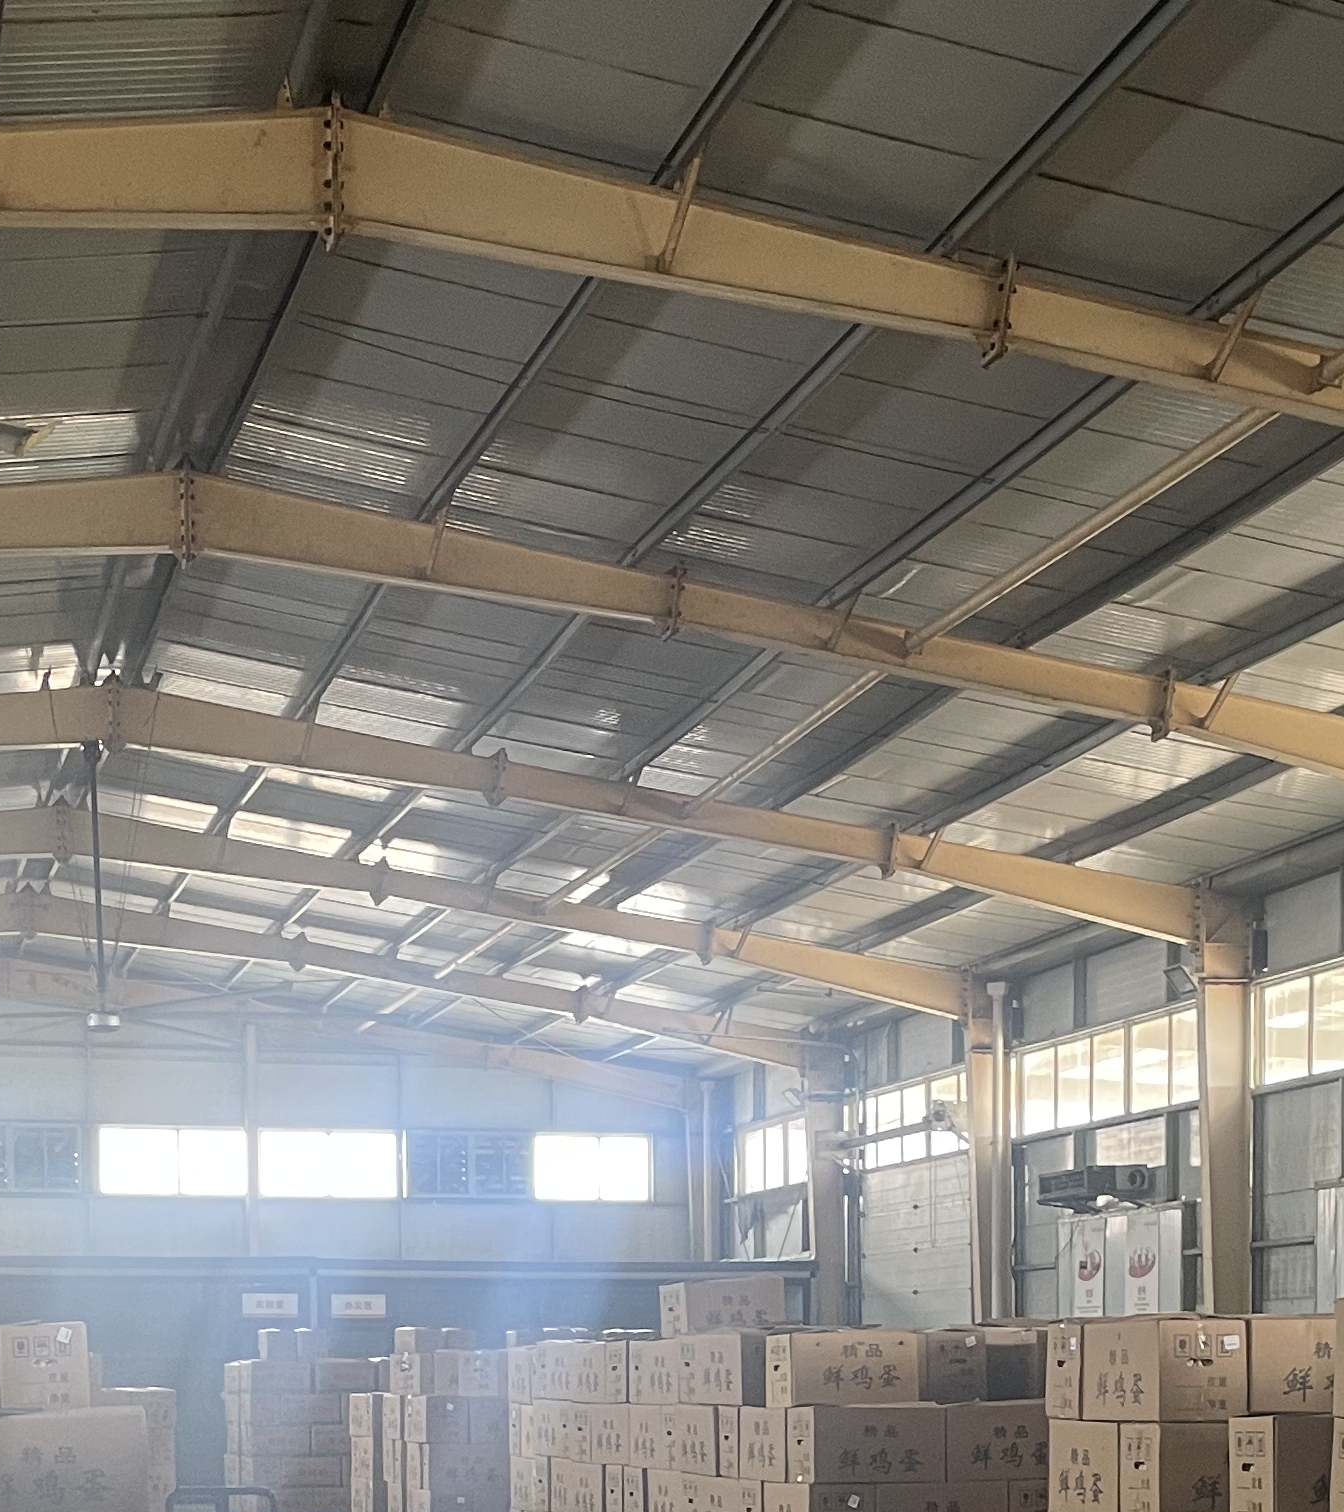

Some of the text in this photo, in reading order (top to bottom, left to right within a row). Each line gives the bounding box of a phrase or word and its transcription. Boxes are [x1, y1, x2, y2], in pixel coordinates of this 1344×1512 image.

[841, 1343, 884, 1359] 精品
[822, 1364, 902, 1391] 鲜鸡蛋
[1095, 1370, 1145, 1408] 鲜鸡蛋
[993, 1424, 1029, 1439] 精品
[20, 1445, 77, 1466] 精品
[839, 1443, 926, 1476] 鲜鸡蛋
[971, 1440, 1047, 1471] 鲜鸡蛋
